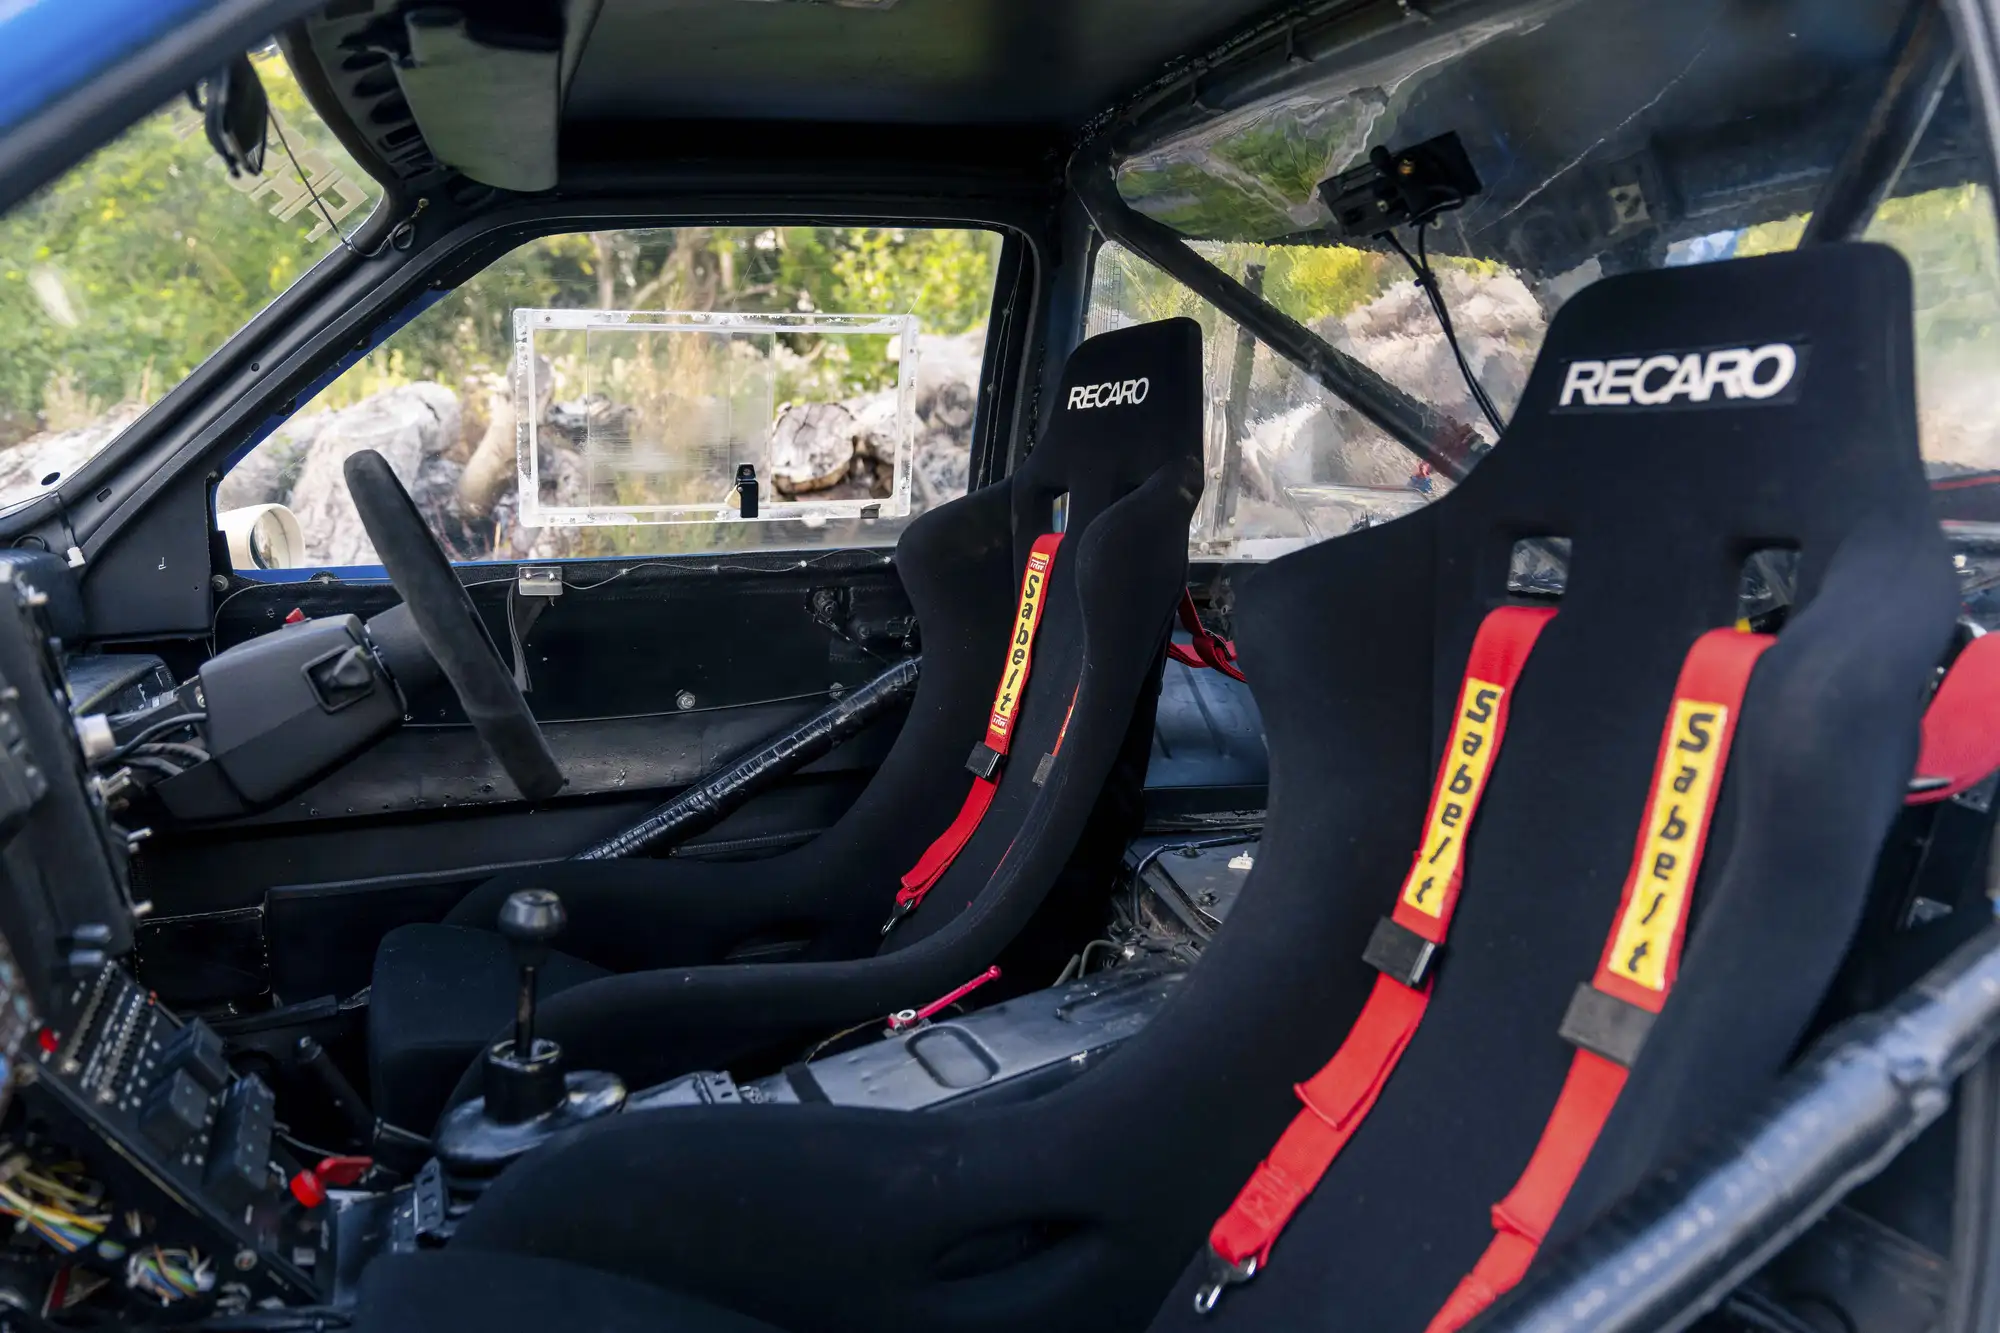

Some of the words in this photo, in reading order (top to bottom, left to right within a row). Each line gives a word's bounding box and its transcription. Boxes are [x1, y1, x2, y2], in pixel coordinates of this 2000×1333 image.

[1067, 377, 1150, 410] RECARO
[1558, 342, 1797, 406] RECARO
[999, 574, 1041, 712] Sabelt
[1415, 688, 1500, 904] Sabelt
[1627, 712, 1715, 974] Sabelt
